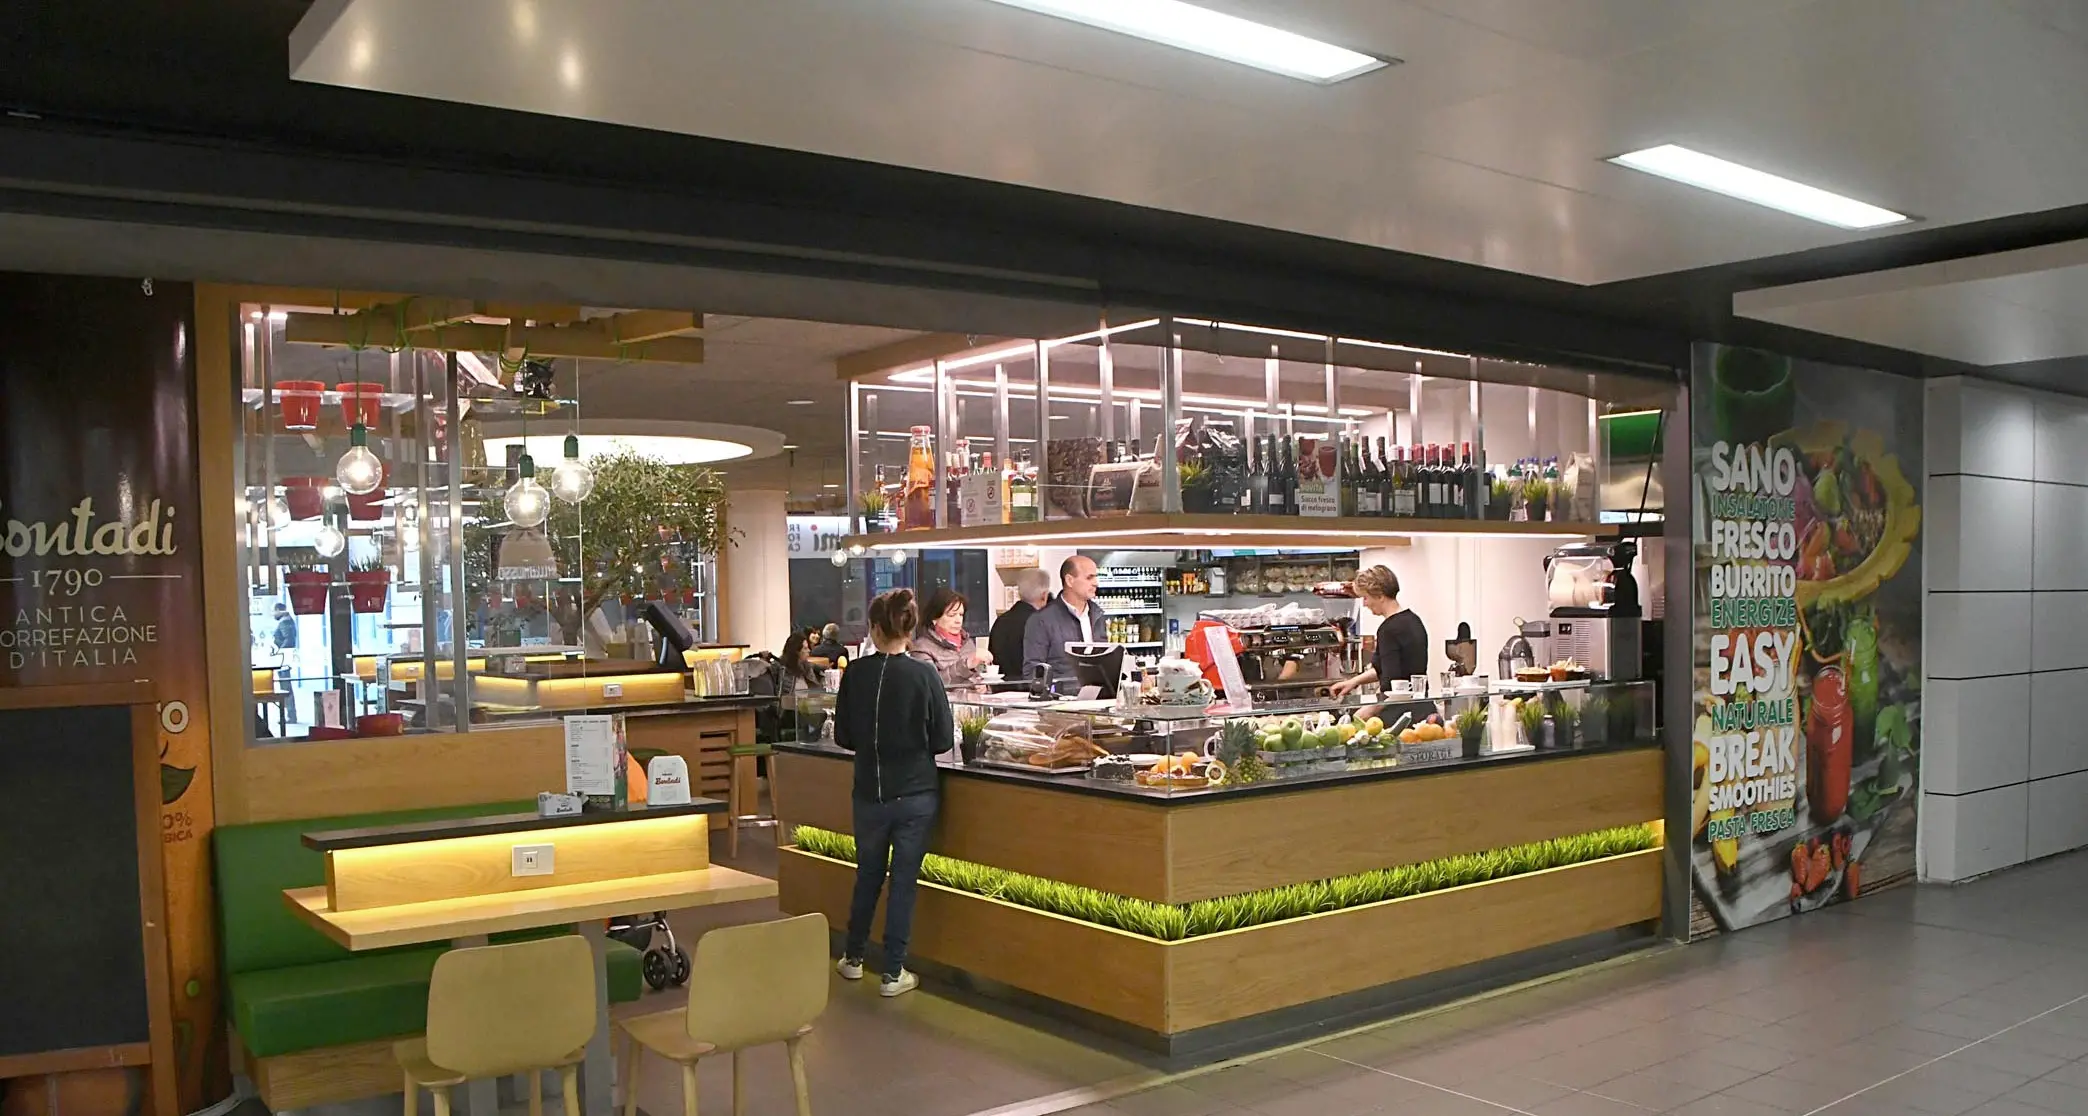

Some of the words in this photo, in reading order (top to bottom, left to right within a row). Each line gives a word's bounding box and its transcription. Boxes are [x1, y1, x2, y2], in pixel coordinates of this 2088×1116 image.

[1711, 440, 1796, 496] SANO
[0, 497, 177, 557] ontadi
[1711, 520, 1796, 560] FRESCO
[31, 568, 103, 596] 1790
[1711, 564, 1796, 598] BURRITO
[16, 605, 127, 625] ANTICA
[1711, 597, 1796, 628] ENERGIZE
[0, 625, 158, 648] ORREFAZIONE
[9, 648, 138, 669] D'ITALIA
[1710, 631, 1795, 695] EASY
[1711, 699, 1794, 732] NATURALE
[1709, 727, 1796, 783] BREAK
[1708, 775, 1796, 812] SMOOTHIES
[163, 811, 193, 829] 0%
[1708, 814, 1748, 843] PASTA
[1750, 807, 1796, 834] FRESCA
